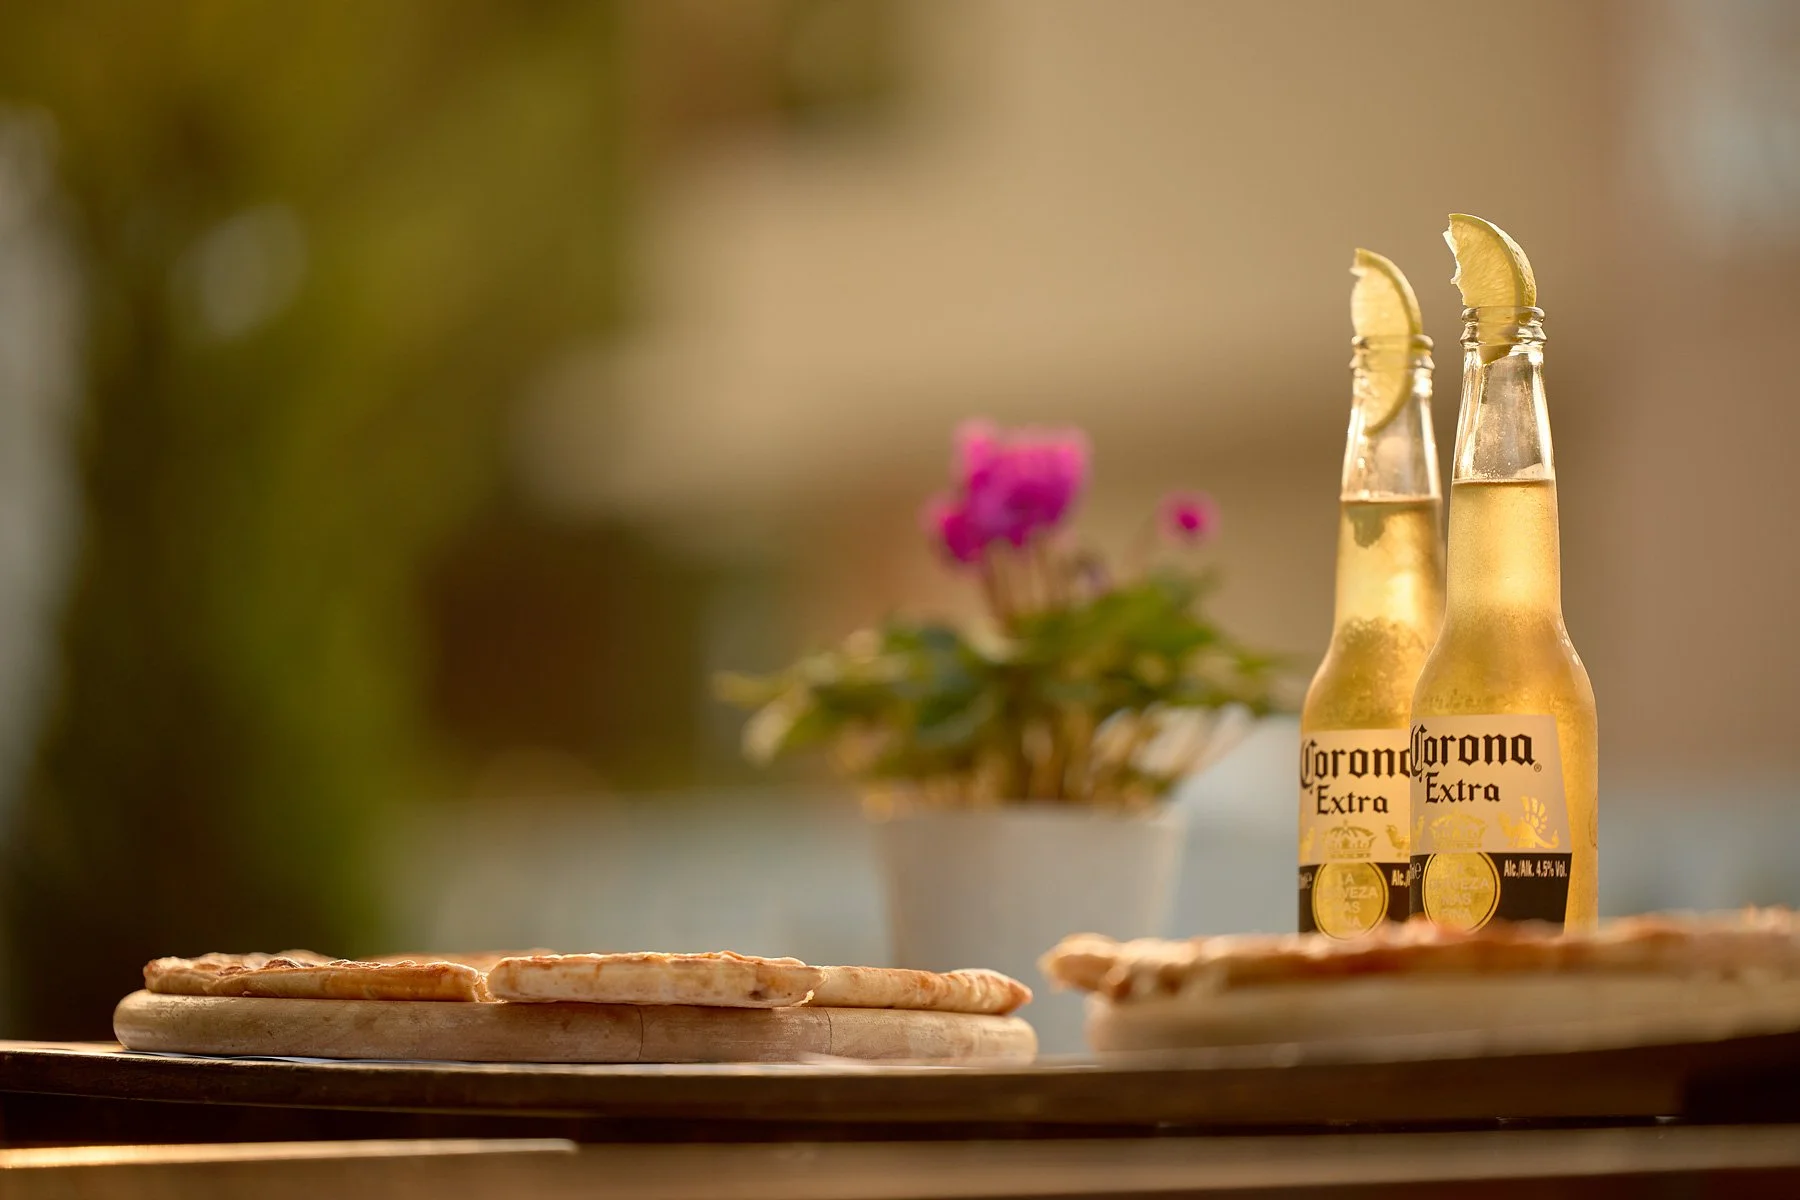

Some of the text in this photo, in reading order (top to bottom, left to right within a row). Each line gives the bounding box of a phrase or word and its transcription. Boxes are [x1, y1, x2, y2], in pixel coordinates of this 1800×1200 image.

[1410, 724, 1535, 783] Corona
[1317, 784, 1388, 814] Extra
[1425, 771, 1500, 803] Extra
[1536, 860, 1555, 877] 4.5%
[1555, 860, 1567, 877] Vol.
